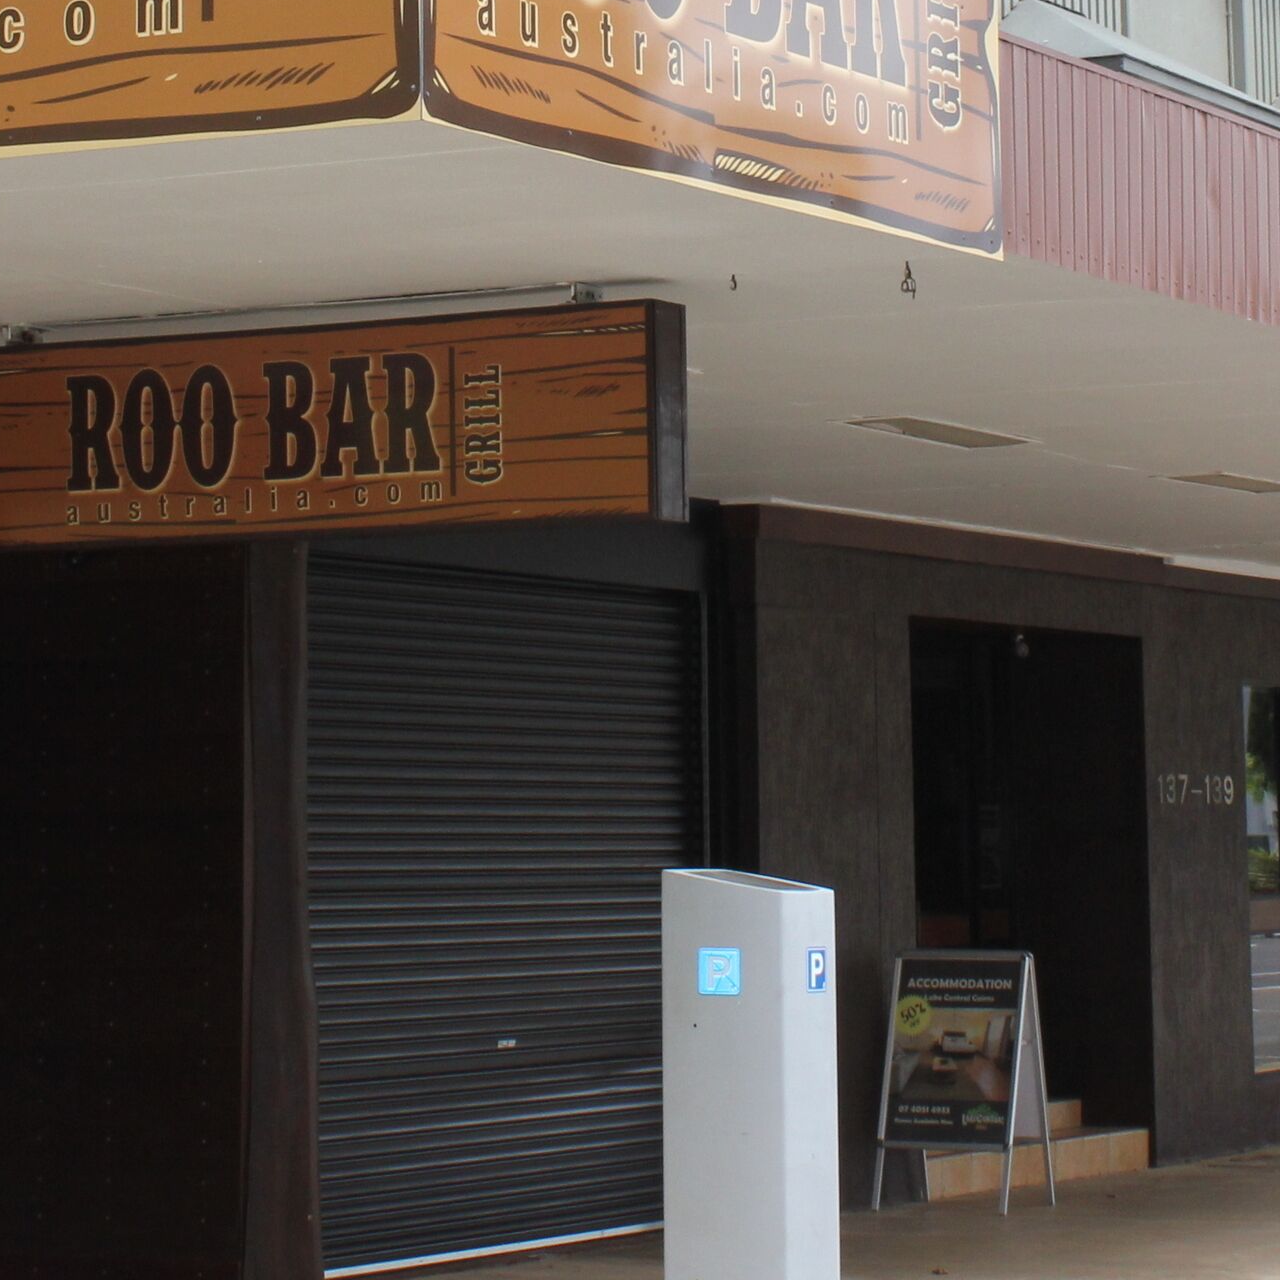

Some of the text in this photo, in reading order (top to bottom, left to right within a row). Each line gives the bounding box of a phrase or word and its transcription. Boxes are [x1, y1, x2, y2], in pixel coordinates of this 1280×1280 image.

[66, 352, 441, 492] ROO BAR
[464, 364, 503, 485] GRILL
[65, 479, 443, 525] australia.com
[1158, 774, 1234, 805] 137-139
[907, 977, 1013, 990] ACCOMMODATION
